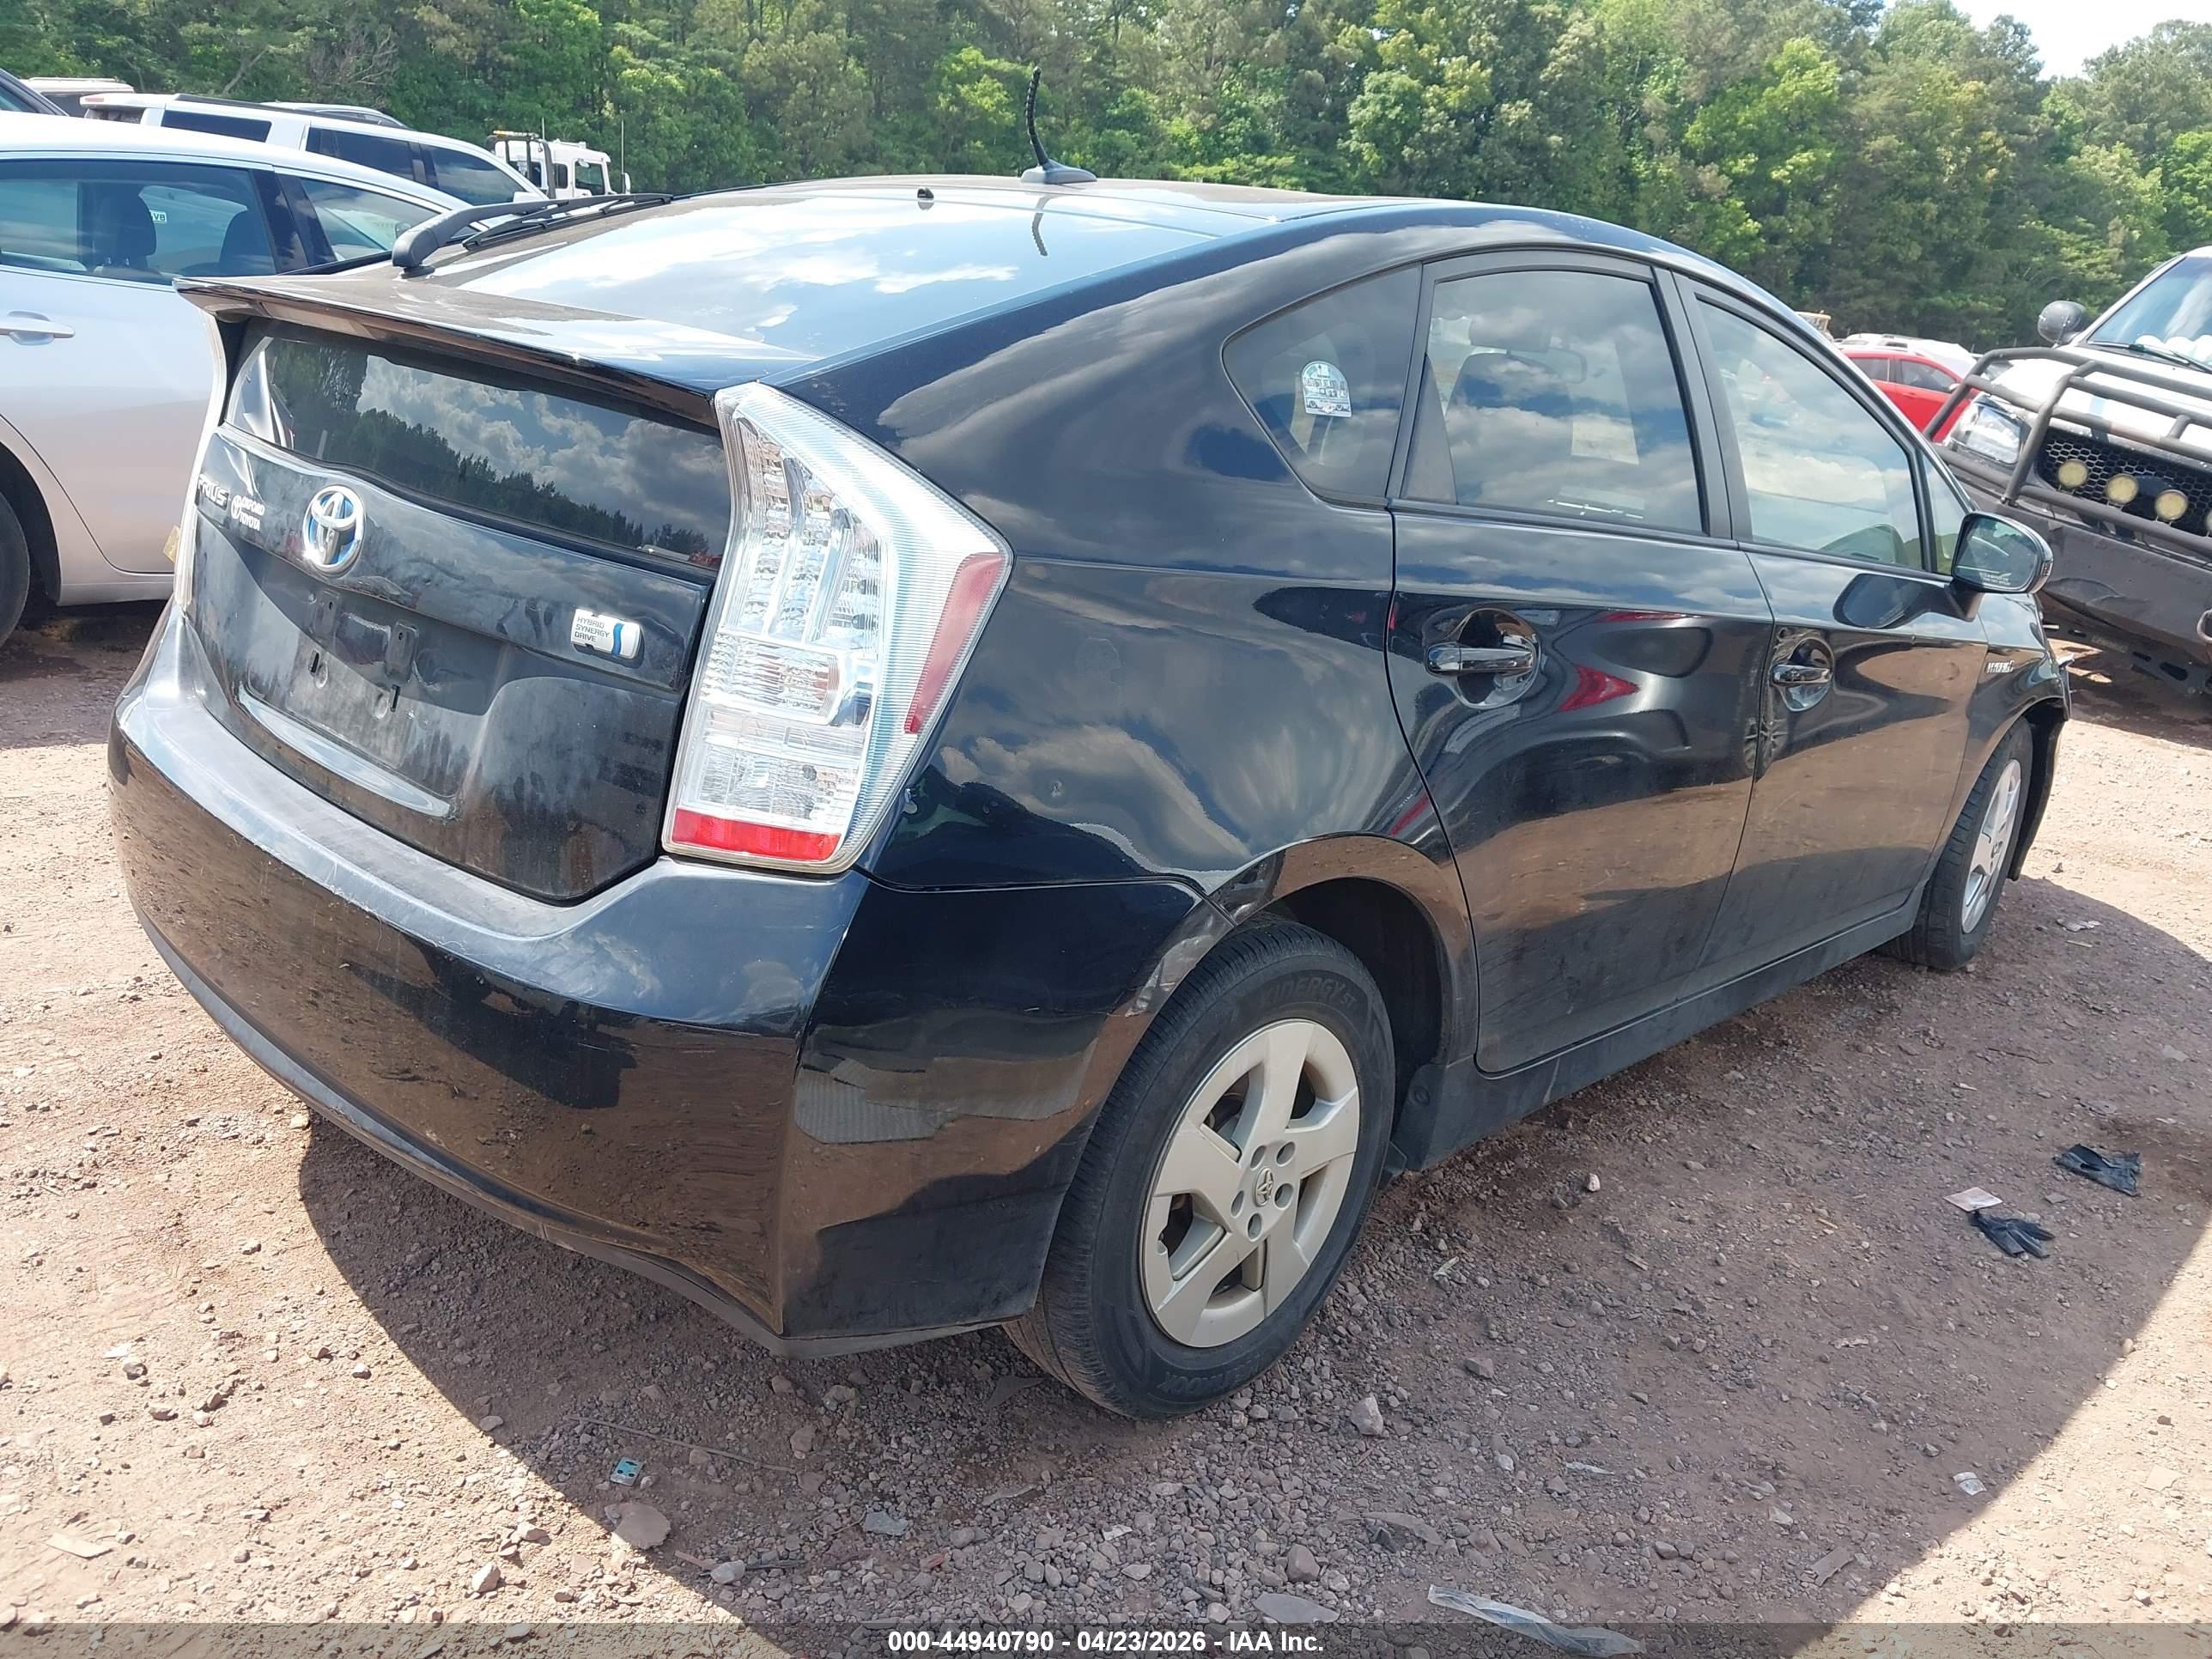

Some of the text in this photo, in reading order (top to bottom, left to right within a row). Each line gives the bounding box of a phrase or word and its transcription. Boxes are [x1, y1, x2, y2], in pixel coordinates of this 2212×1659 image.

[198, 474, 229, 507] PRIUS
[240, 512, 260, 531] TOYOTA
[574, 623, 611, 638] SYNERGY
[577, 617, 605, 629] HYBRID
[574, 631, 597, 642] DRIVE
